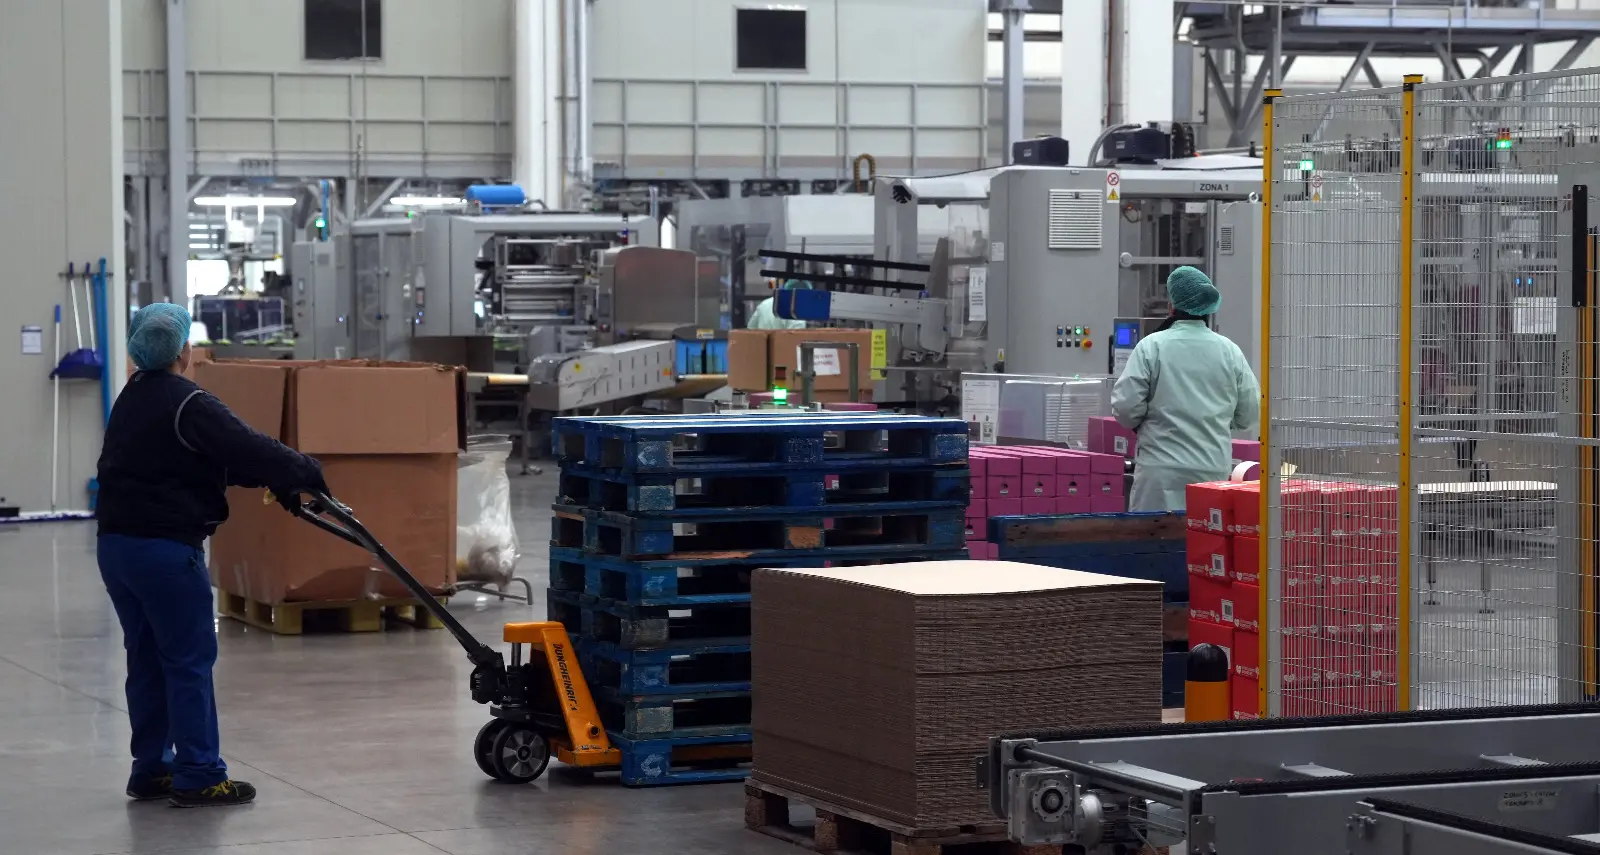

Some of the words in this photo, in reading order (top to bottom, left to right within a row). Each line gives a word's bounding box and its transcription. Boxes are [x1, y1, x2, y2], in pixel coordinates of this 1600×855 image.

[1199, 183, 1223, 191] ZONA
[1225, 183, 1229, 191] 1
[552, 643, 578, 712] JUNGHEINRI
